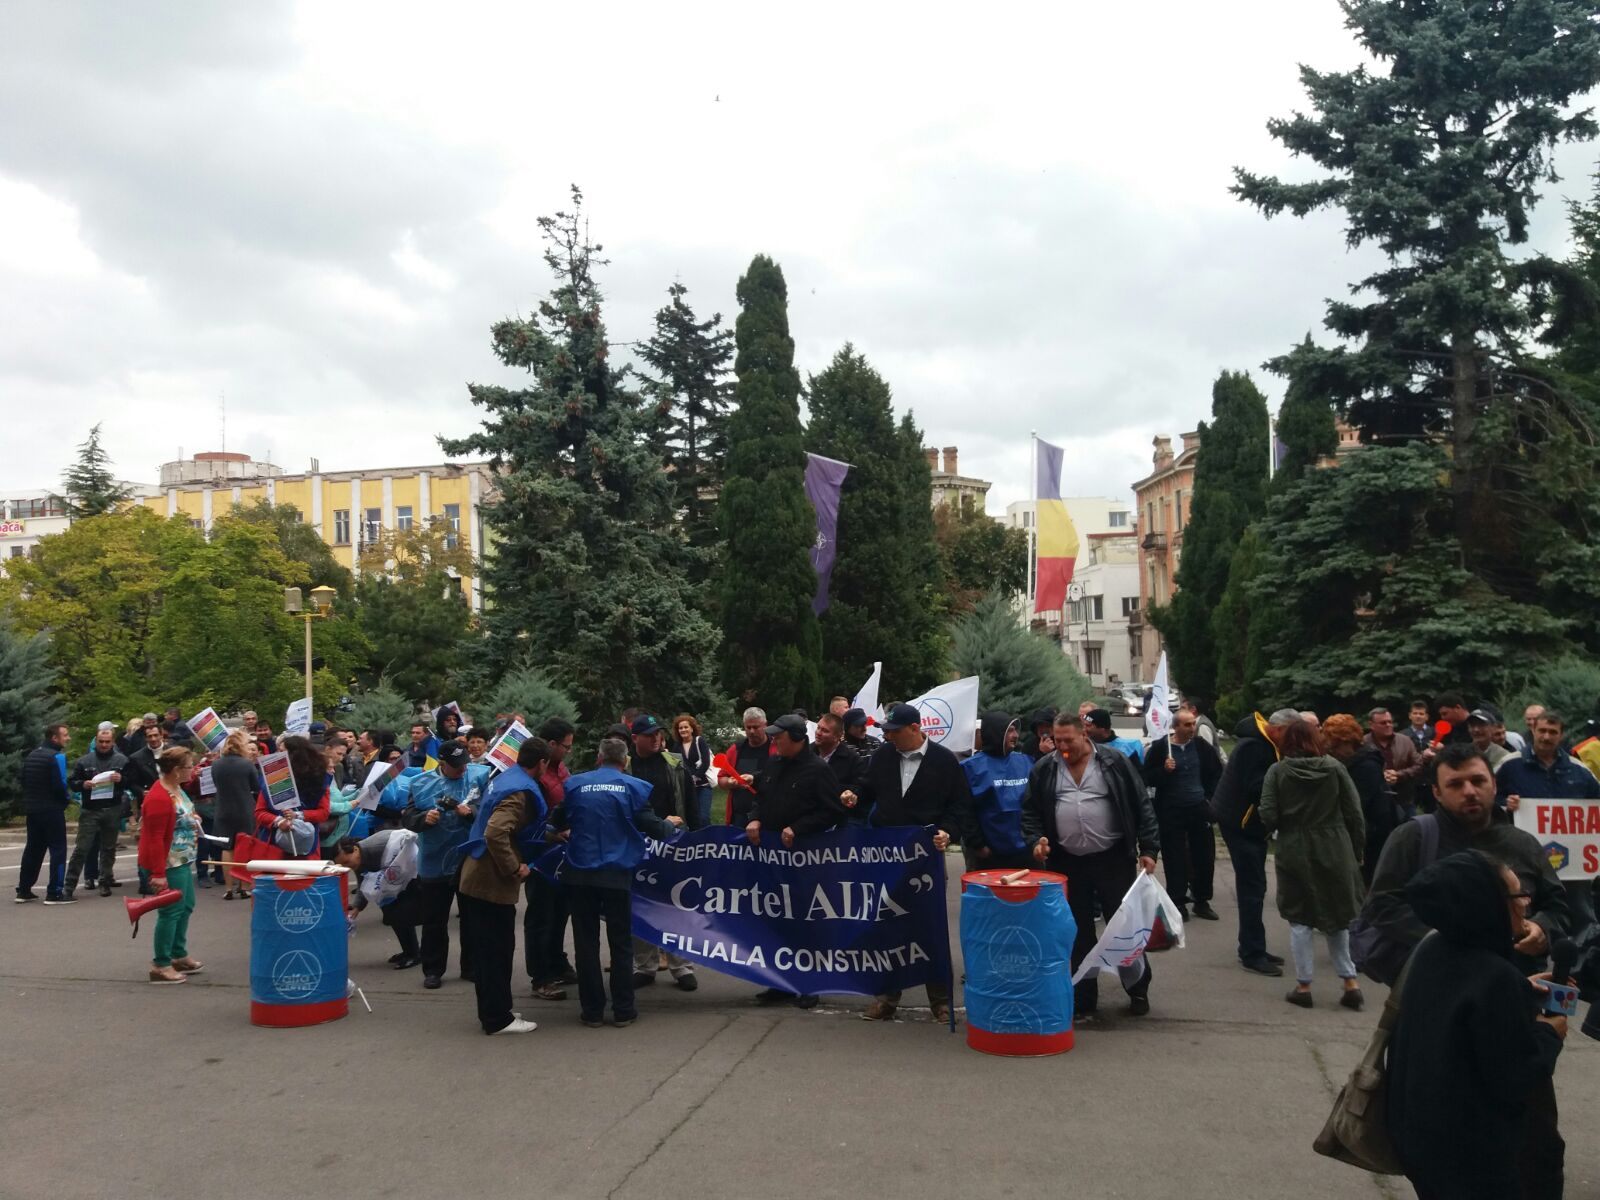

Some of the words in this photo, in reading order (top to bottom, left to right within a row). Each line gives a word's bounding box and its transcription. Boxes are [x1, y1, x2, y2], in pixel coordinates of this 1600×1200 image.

[1536, 805, 1600, 834] FARA
[644, 836, 758, 862] ONFEDERATIA
[759, 847, 859, 868] NATIONALA
[861, 842, 929, 864] SINDICALA
[670, 876, 797, 920] Cartel
[804, 881, 910, 922] ALFA
[662, 932, 767, 969] FILIALA
[774, 942, 930, 973] CONSTANTA
